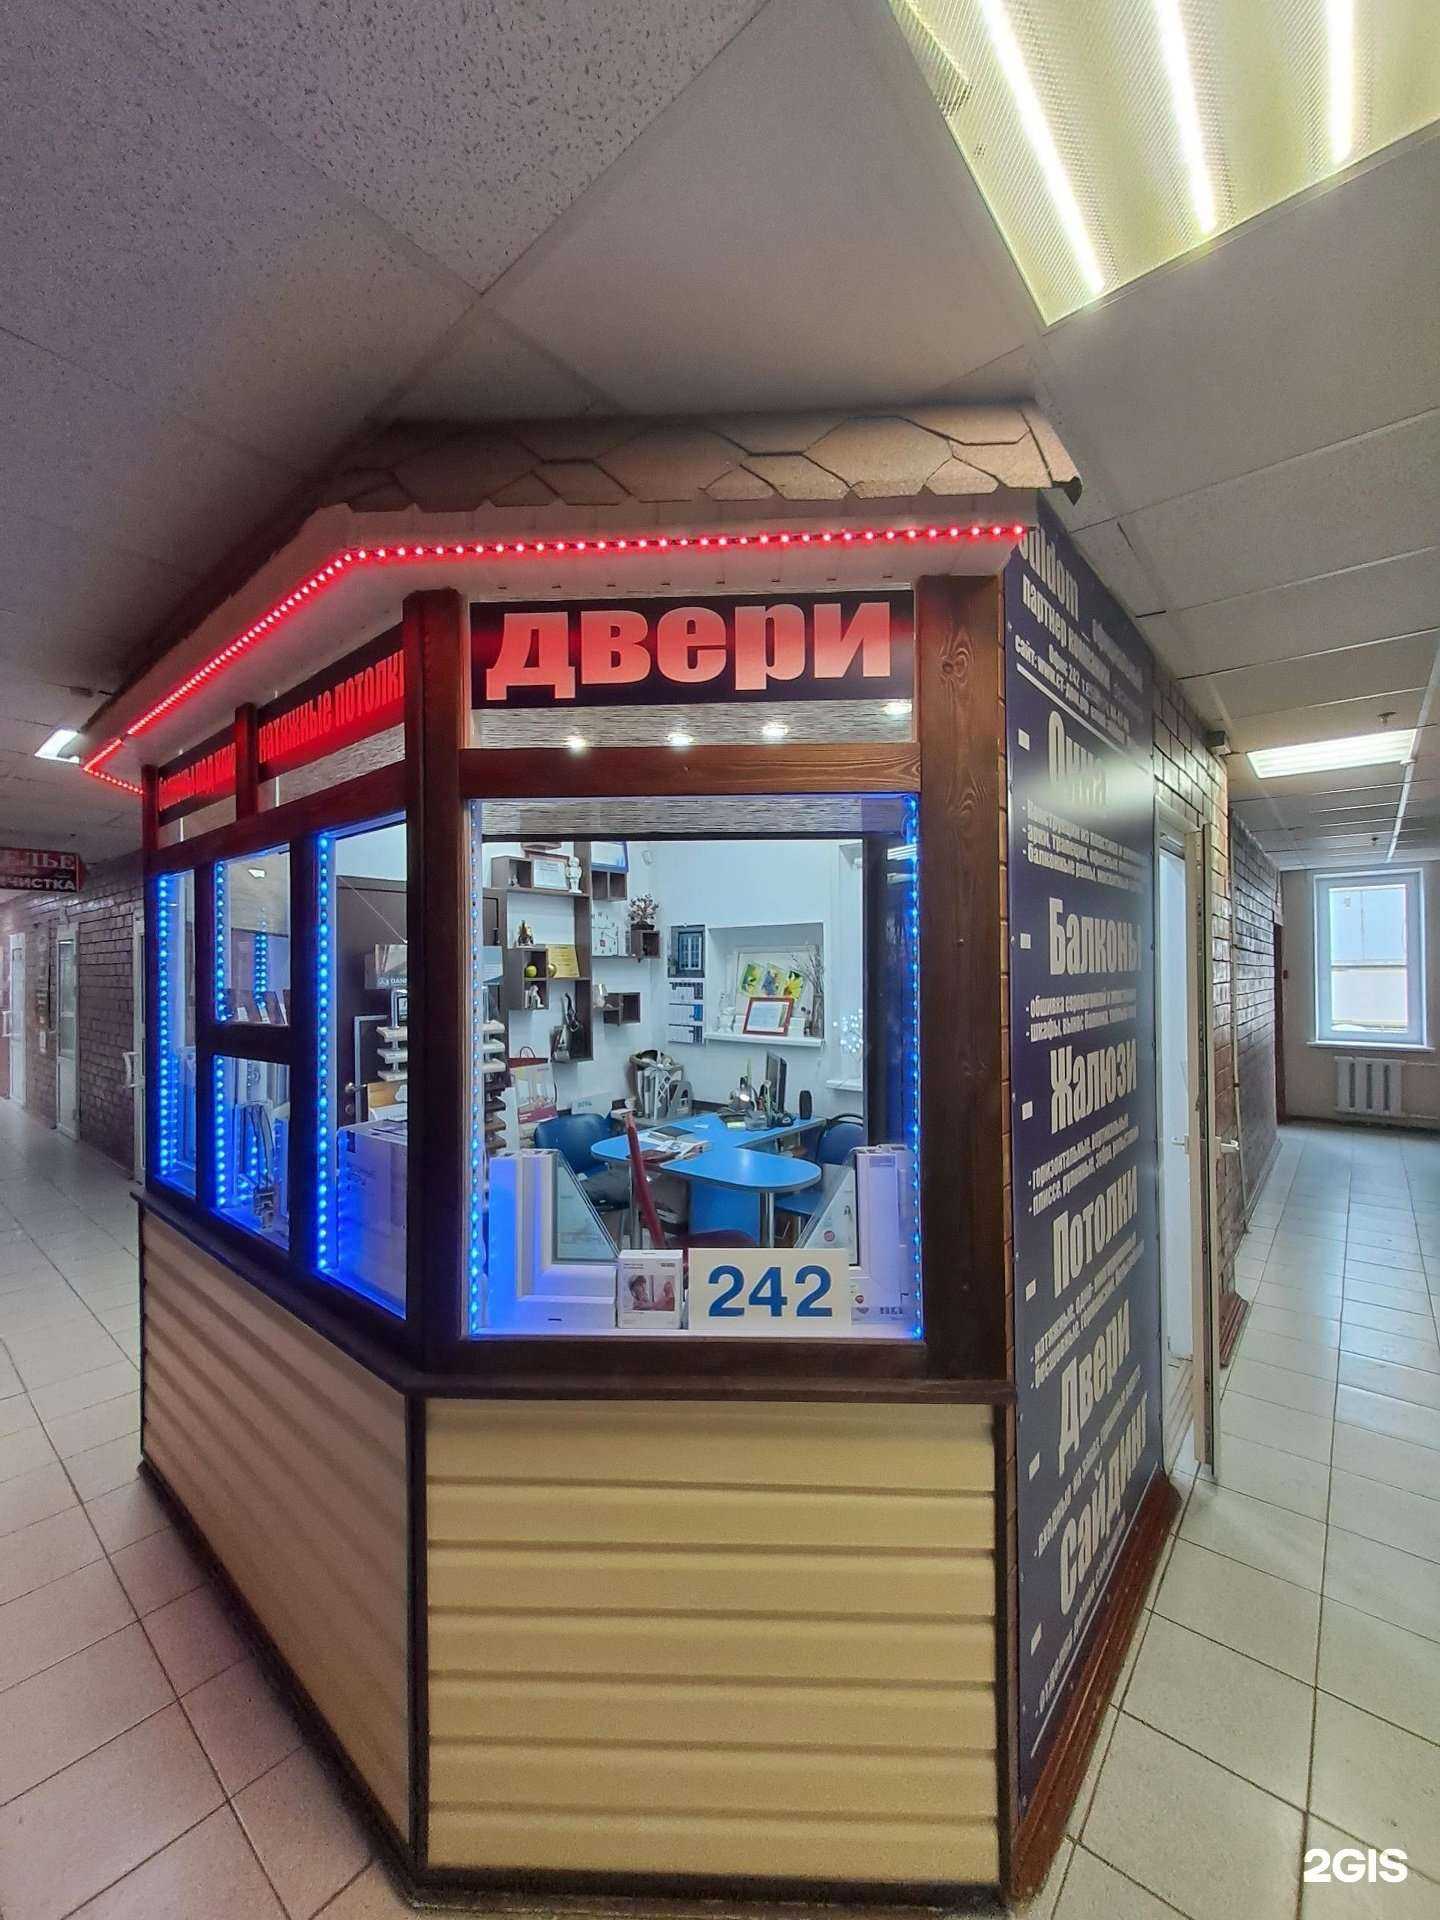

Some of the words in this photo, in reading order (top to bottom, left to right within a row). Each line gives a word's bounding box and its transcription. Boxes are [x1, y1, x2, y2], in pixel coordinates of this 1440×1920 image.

[486, 602, 890, 700] двери
[1023, 573, 1067, 649] партнер
[258, 690, 332, 764] натяжные
[1049, 897, 1142, 976] Балконы
[1050, 1039, 1137, 1135] Жалюзи
[1053, 1165, 1138, 1299] Потолки
[708, 1265, 833, 1317] 242
[1058, 1299, 1131, 1478] Двери
[1060, 1389, 1148, 1616] Сайдинг
